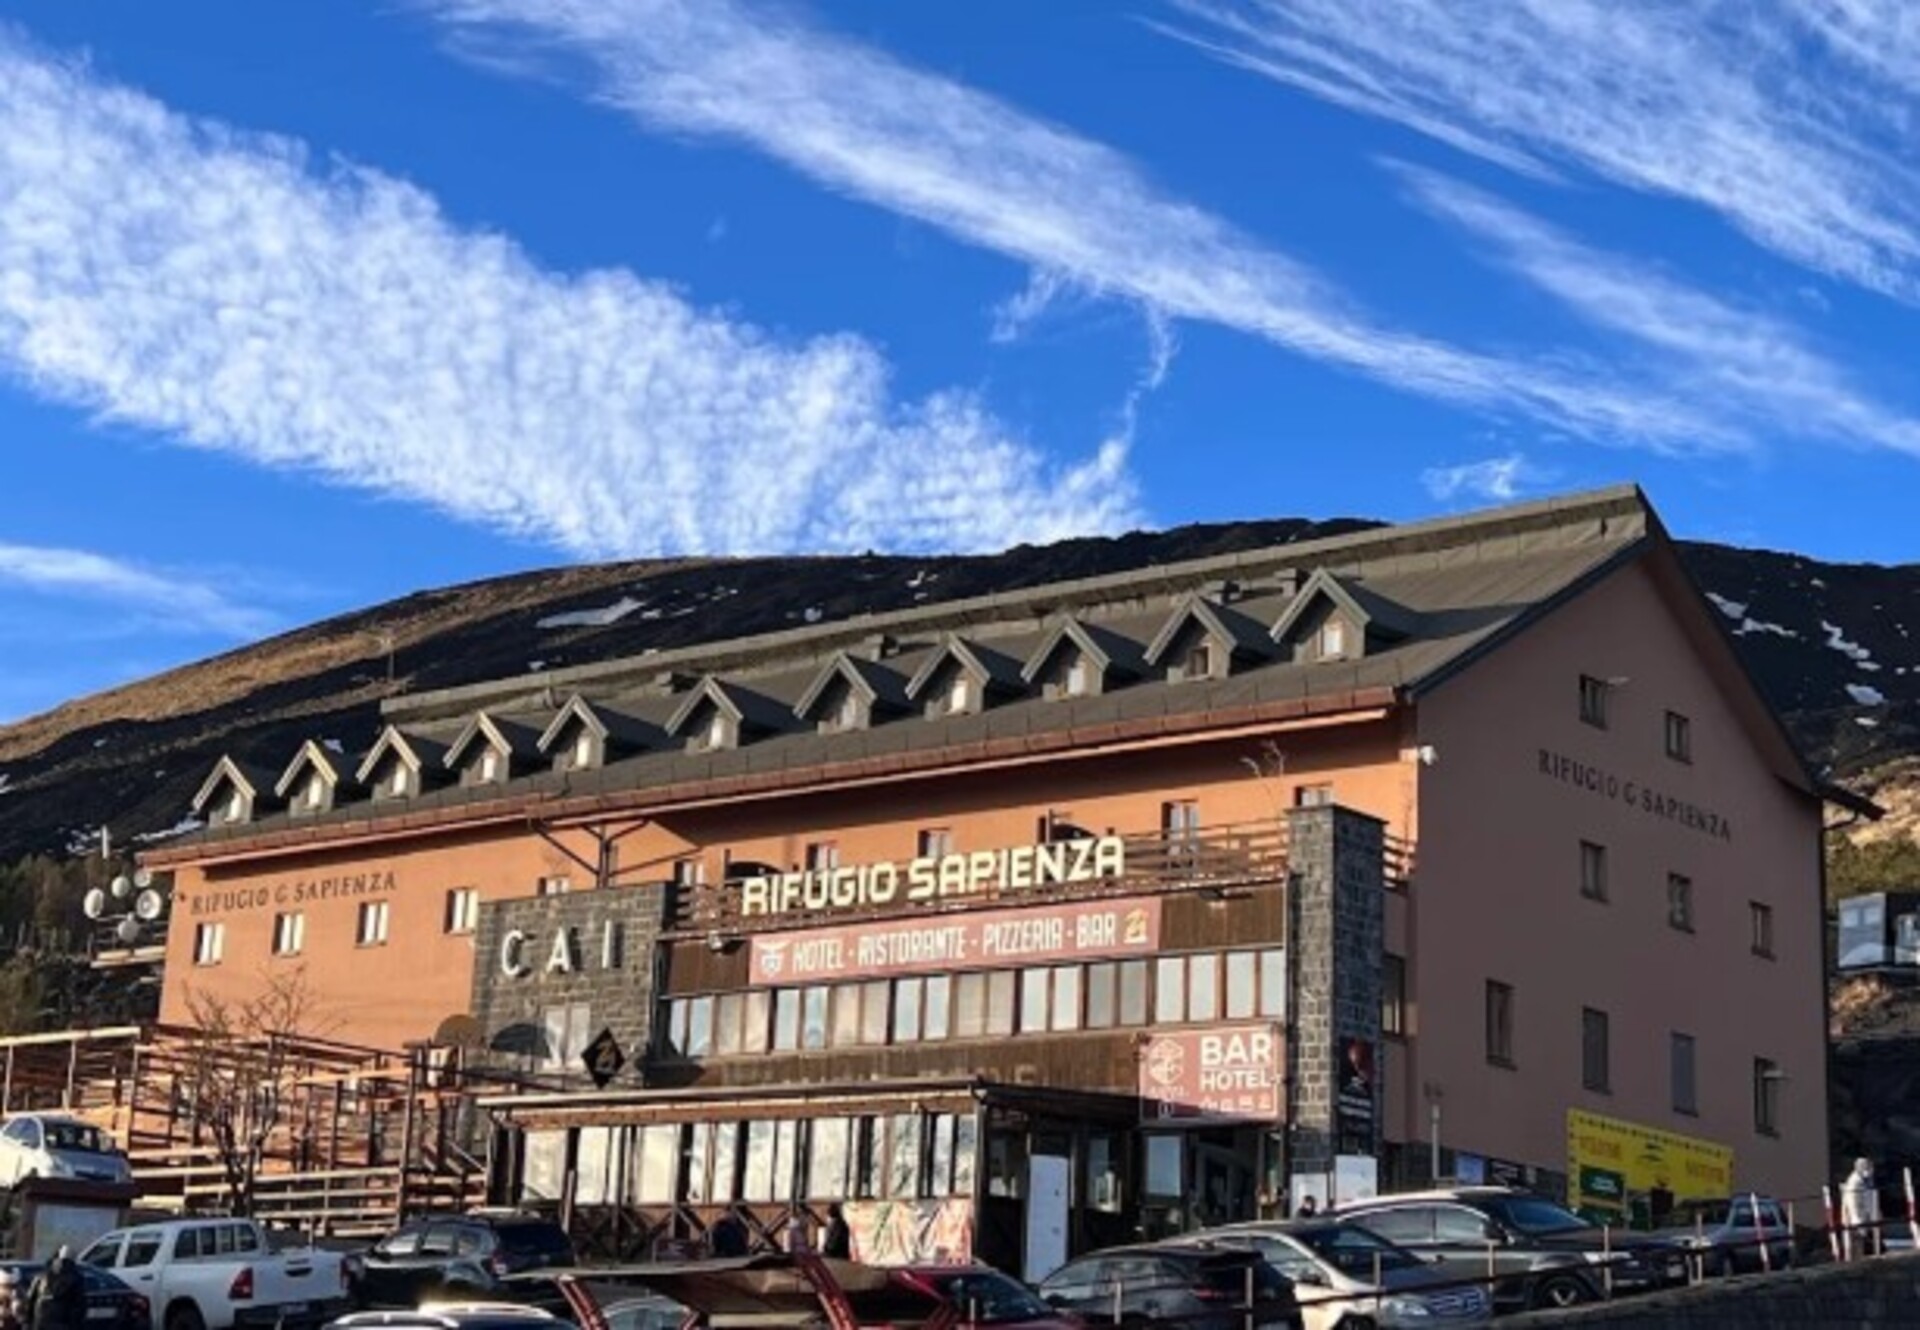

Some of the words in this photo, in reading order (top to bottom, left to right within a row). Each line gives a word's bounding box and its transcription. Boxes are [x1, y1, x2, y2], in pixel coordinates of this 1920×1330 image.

[1642, 788, 1731, 843] SAPIENZA
[292, 871, 397, 903] SAPIENZA
[742, 861, 898, 916] RIFUGIO
[908, 836, 1124, 899] SAPIENZA
[792, 938, 845, 973] HOTEL
[858, 925, 965, 967] RISTORANTE
[982, 916, 1063, 956] PIZZERIA
[1076, 911, 1117, 949] BAR
[1200, 1032, 1272, 1067] BAR
[1200, 1067, 1271, 1093] HOTEL
